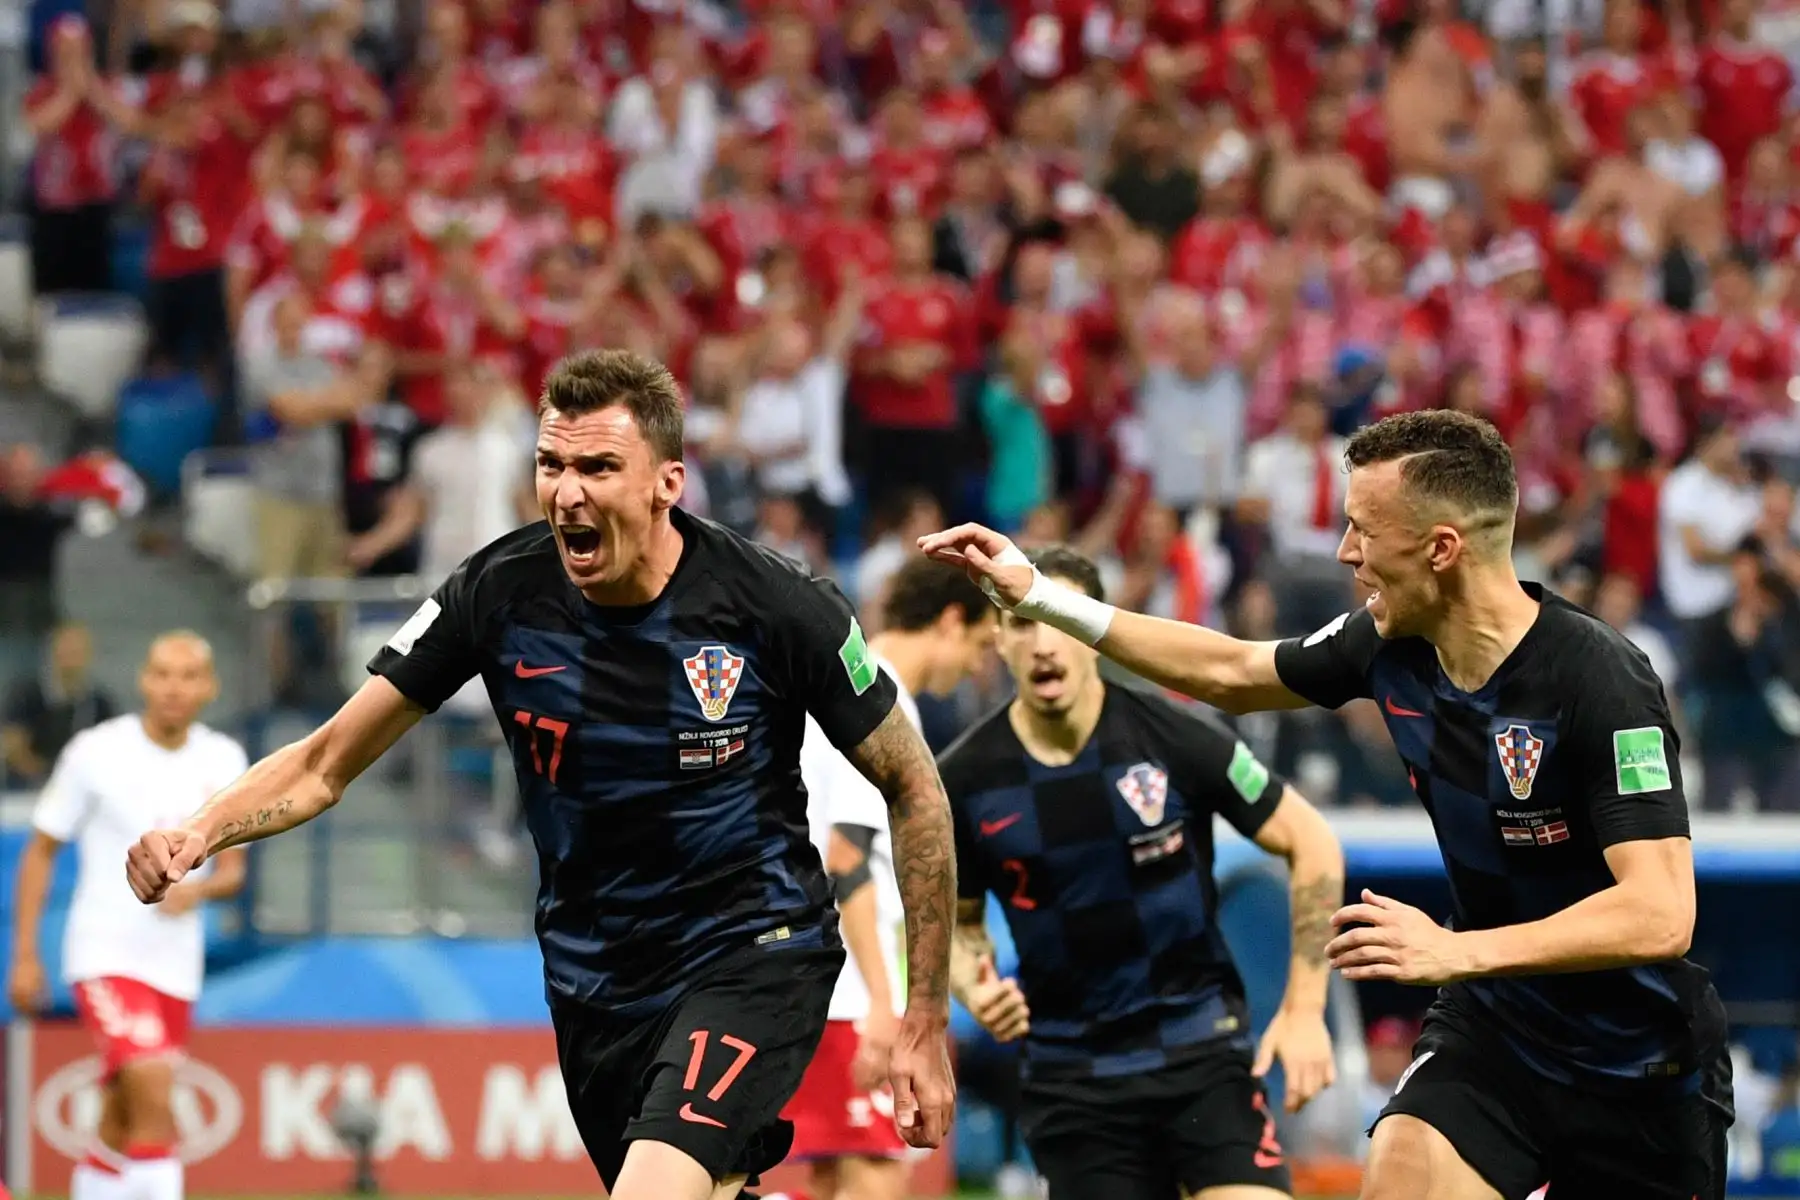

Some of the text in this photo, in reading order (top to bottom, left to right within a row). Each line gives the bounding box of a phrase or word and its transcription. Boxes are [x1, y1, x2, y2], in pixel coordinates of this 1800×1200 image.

[514, 710, 570, 785] 17
[1002, 858, 1038, 911] 2
[683, 1029, 757, 1102] 17
